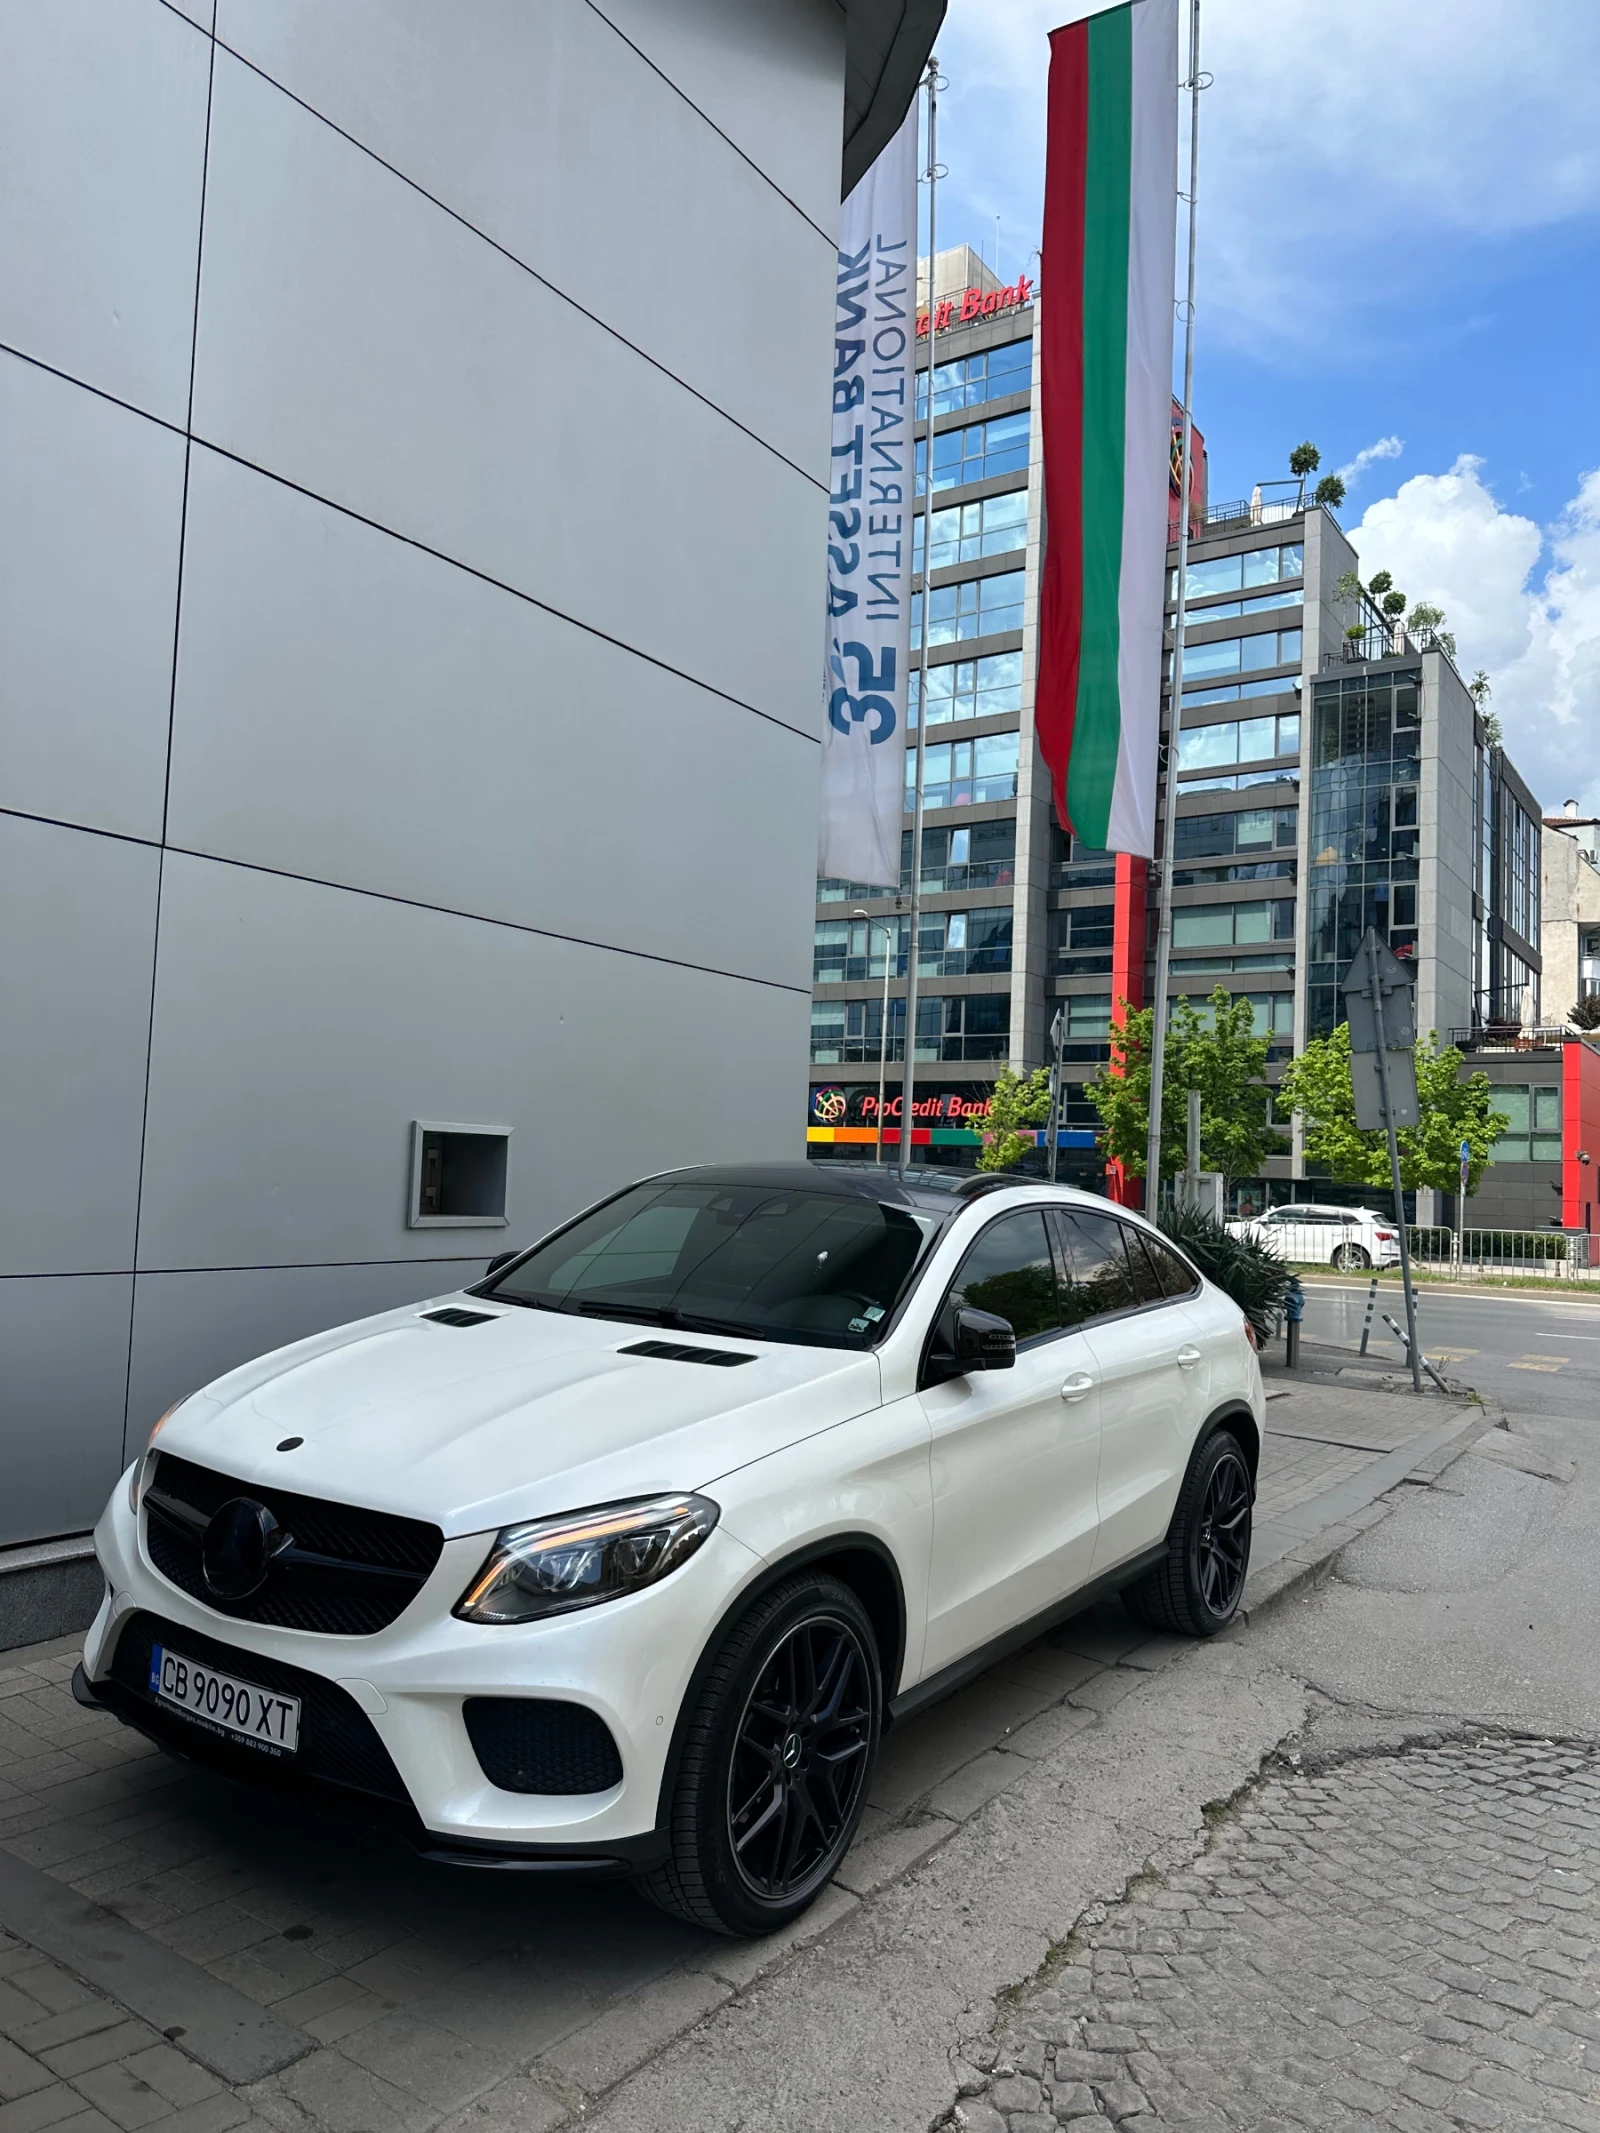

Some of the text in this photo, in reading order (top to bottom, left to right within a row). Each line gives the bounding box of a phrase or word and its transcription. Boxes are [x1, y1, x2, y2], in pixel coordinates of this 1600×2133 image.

[960, 274, 1033, 321] Bank
[861, 1096, 944, 1117] ProCedit
[151, 1671, 160, 1685] BG
[163, 1656, 293, 1740] CB 9090 XT
